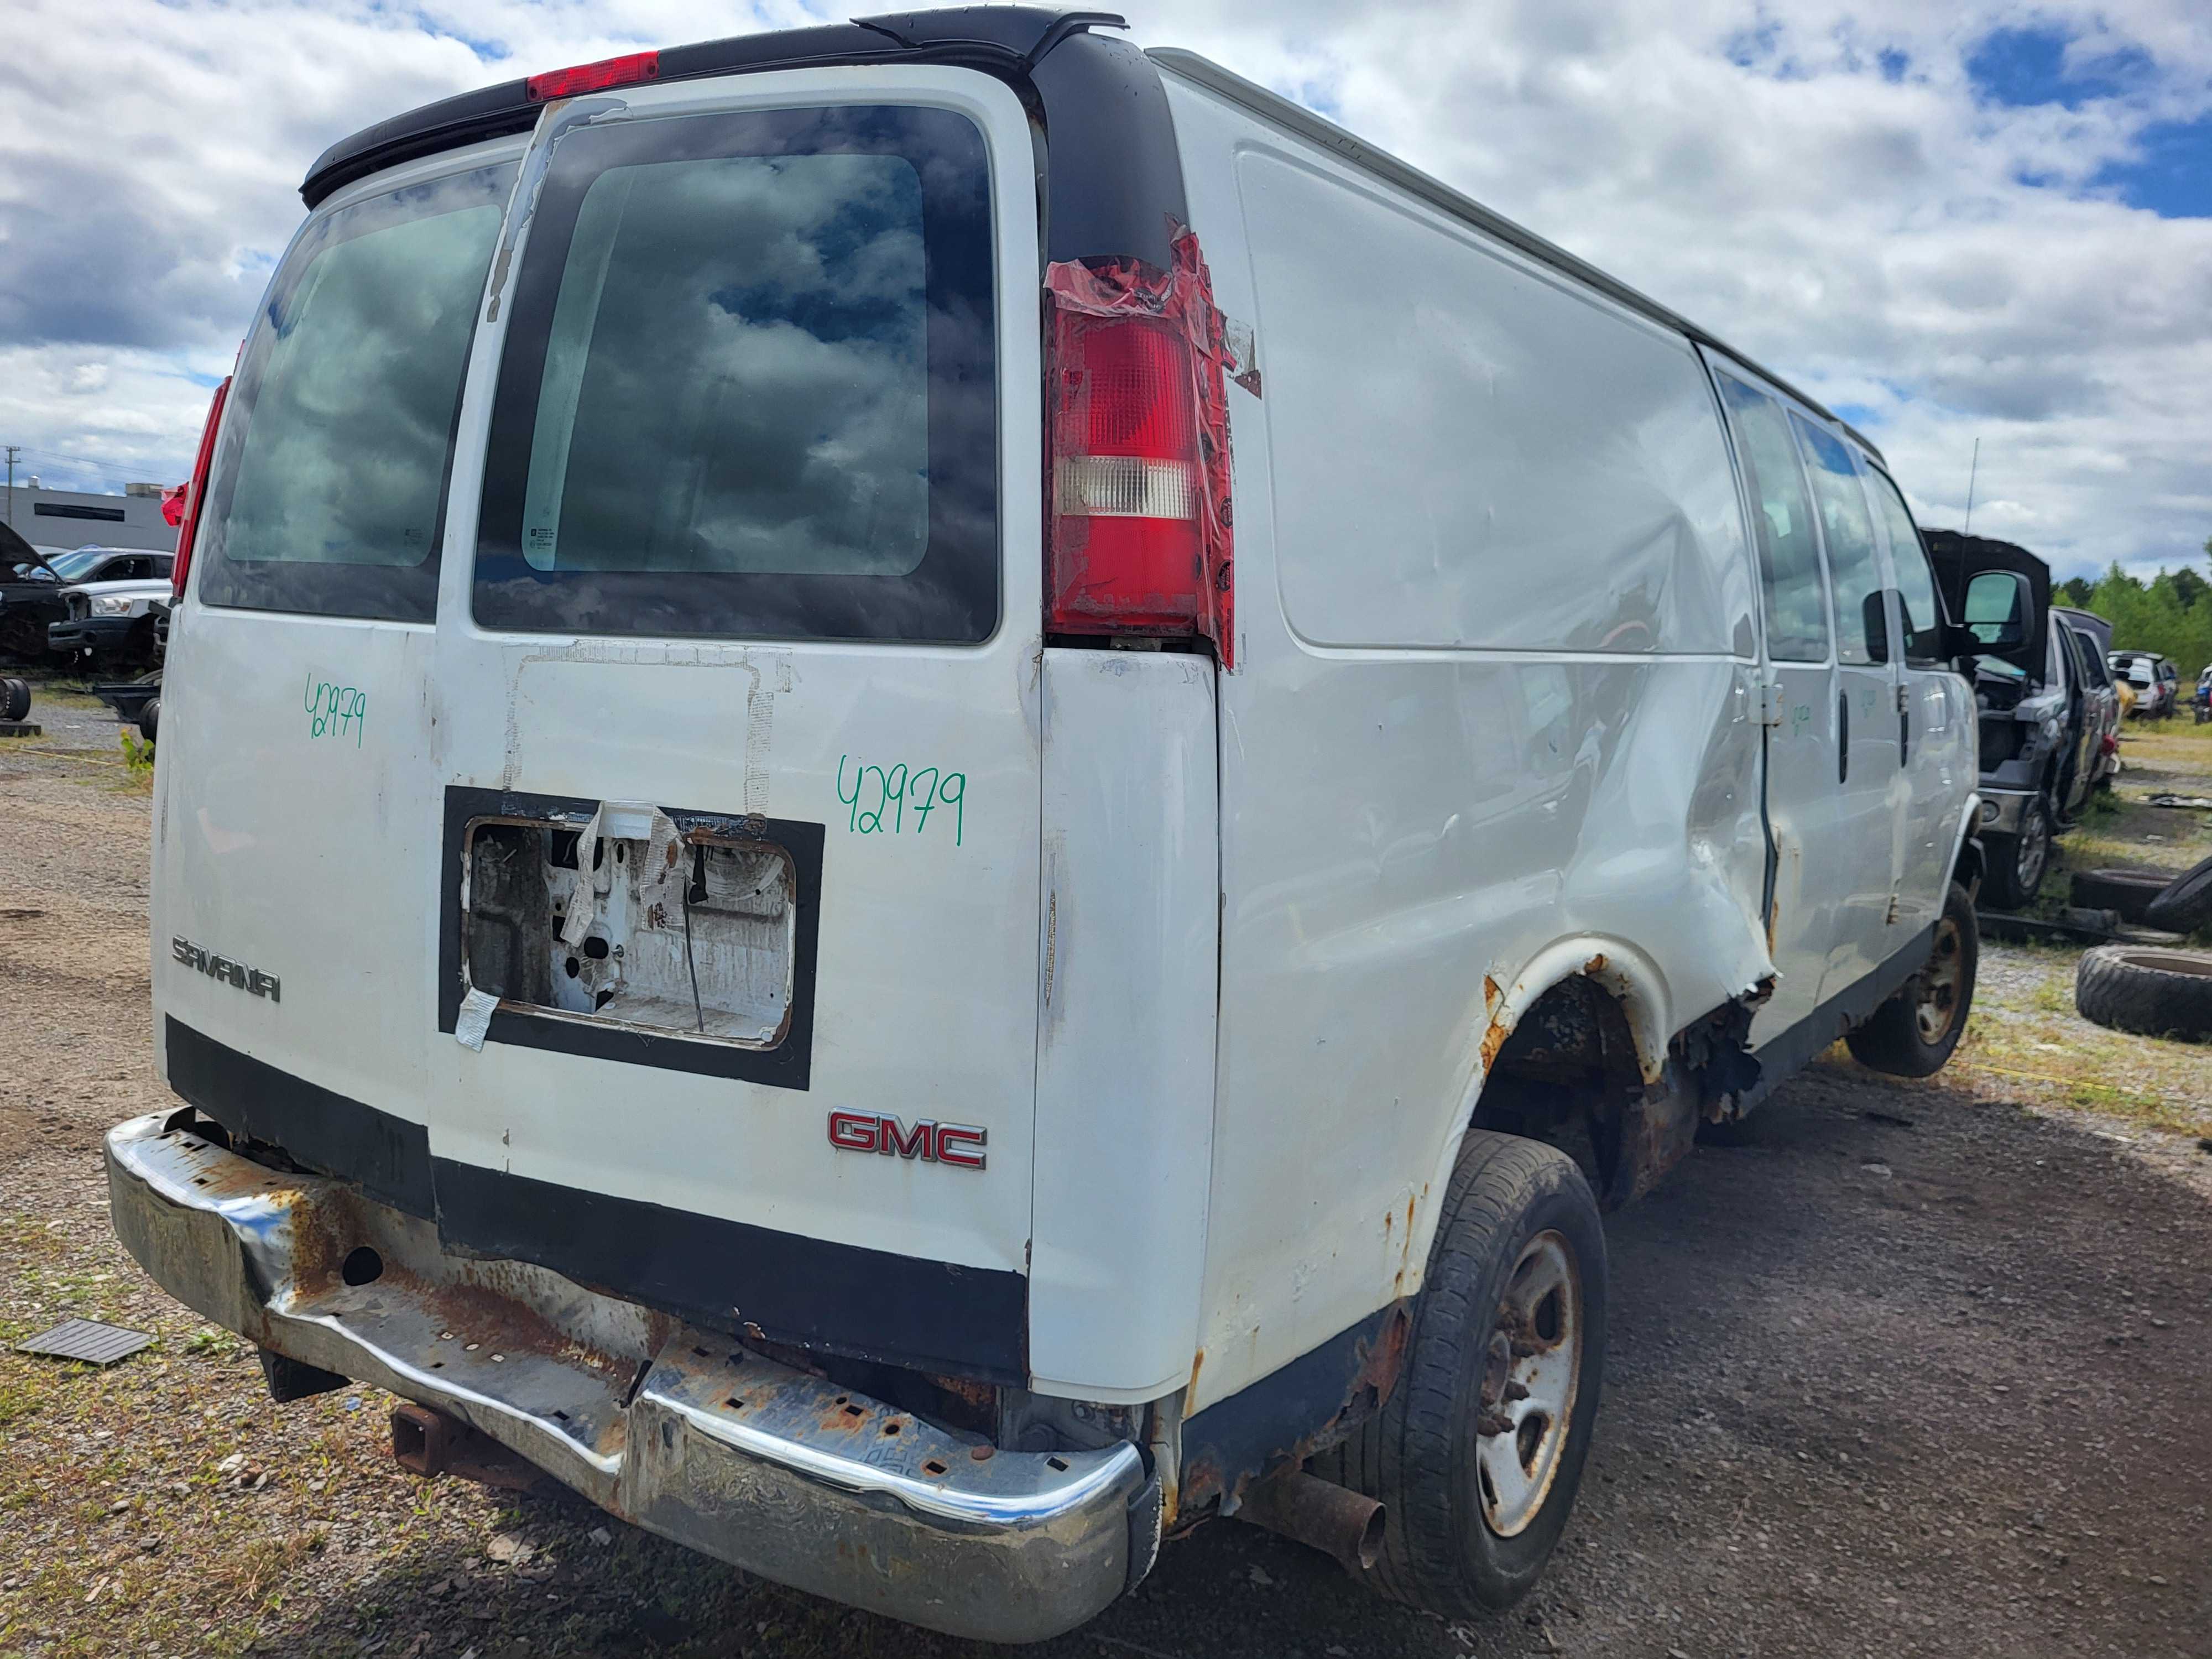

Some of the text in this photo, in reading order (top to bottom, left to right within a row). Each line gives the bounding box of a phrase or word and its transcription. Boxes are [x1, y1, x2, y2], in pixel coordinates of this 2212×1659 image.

[305, 672, 366, 749] 42979
[837, 754, 966, 847] 42979
[172, 934, 280, 1003] SAVANA
[827, 1105, 987, 1171] GMC
